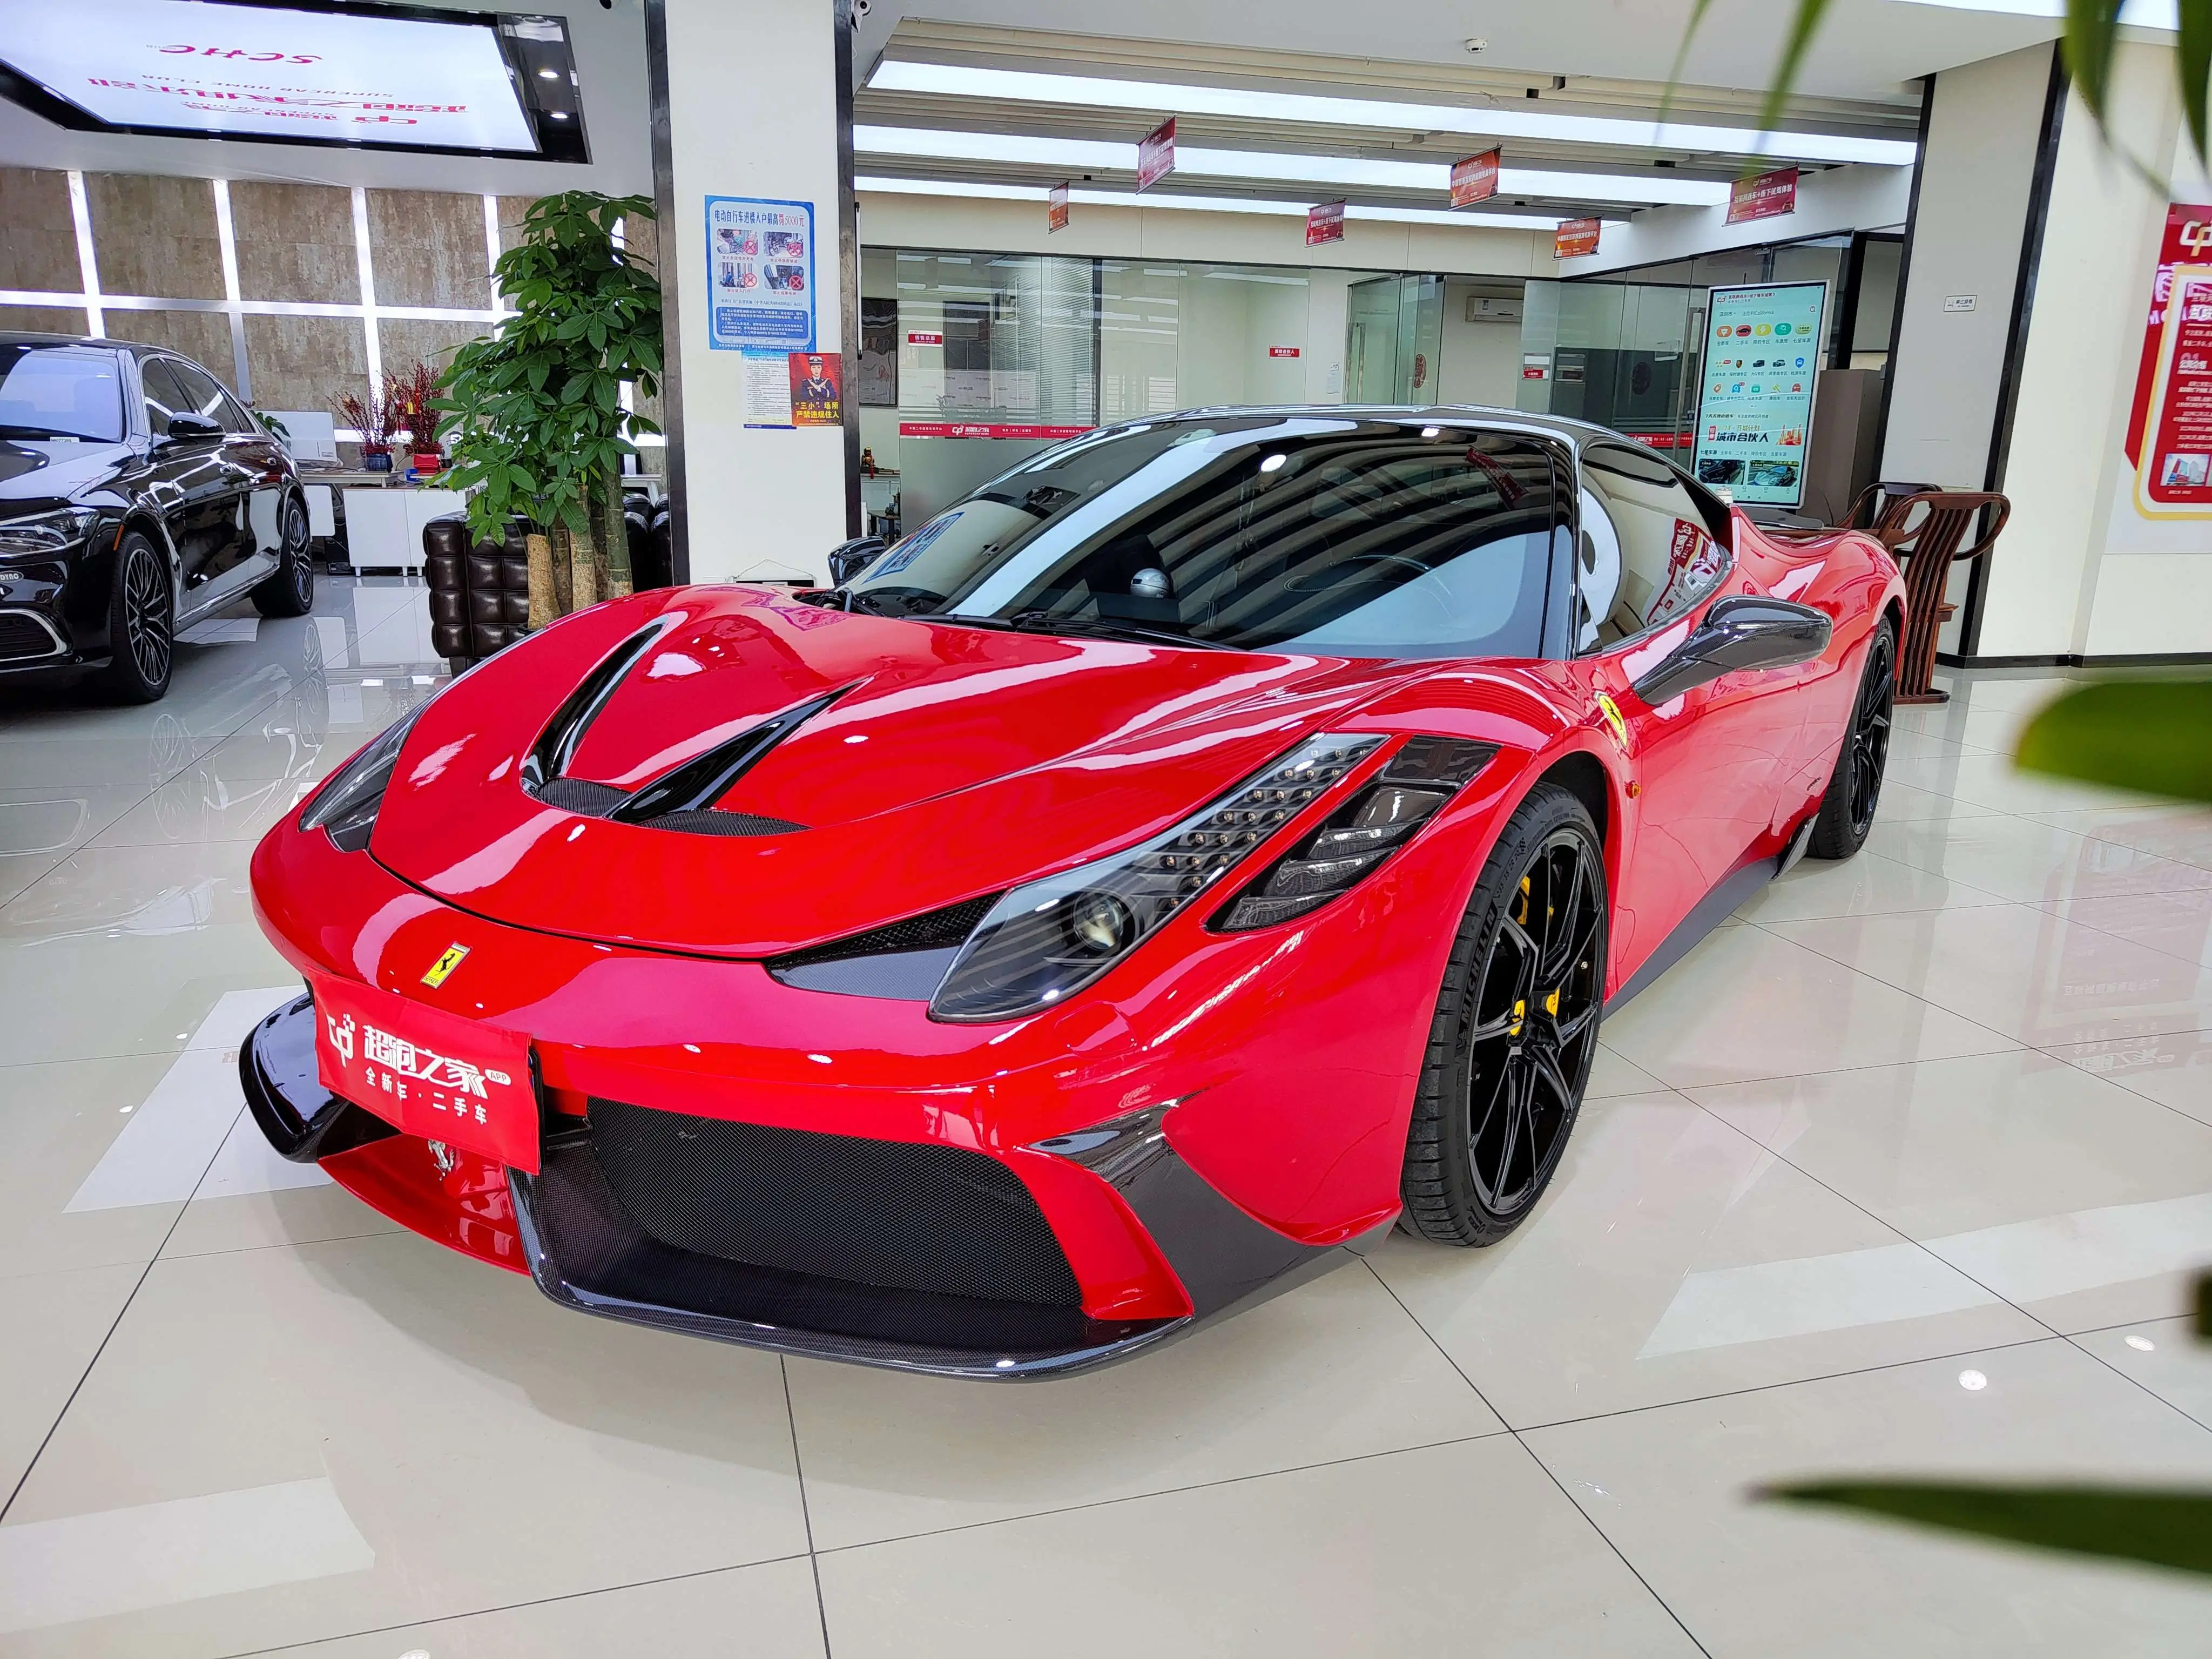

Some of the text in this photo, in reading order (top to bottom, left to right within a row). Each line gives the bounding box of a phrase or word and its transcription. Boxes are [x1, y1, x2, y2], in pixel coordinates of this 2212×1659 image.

[795, 410, 839, 419] 严禁违规住人
[1716, 432, 1769, 443] 城市合伙人
[1461, 908, 1496, 1023] MICHELIN
[362, 1024, 488, 1100] 超跑之家
[490, 1071, 507, 1082] APP
